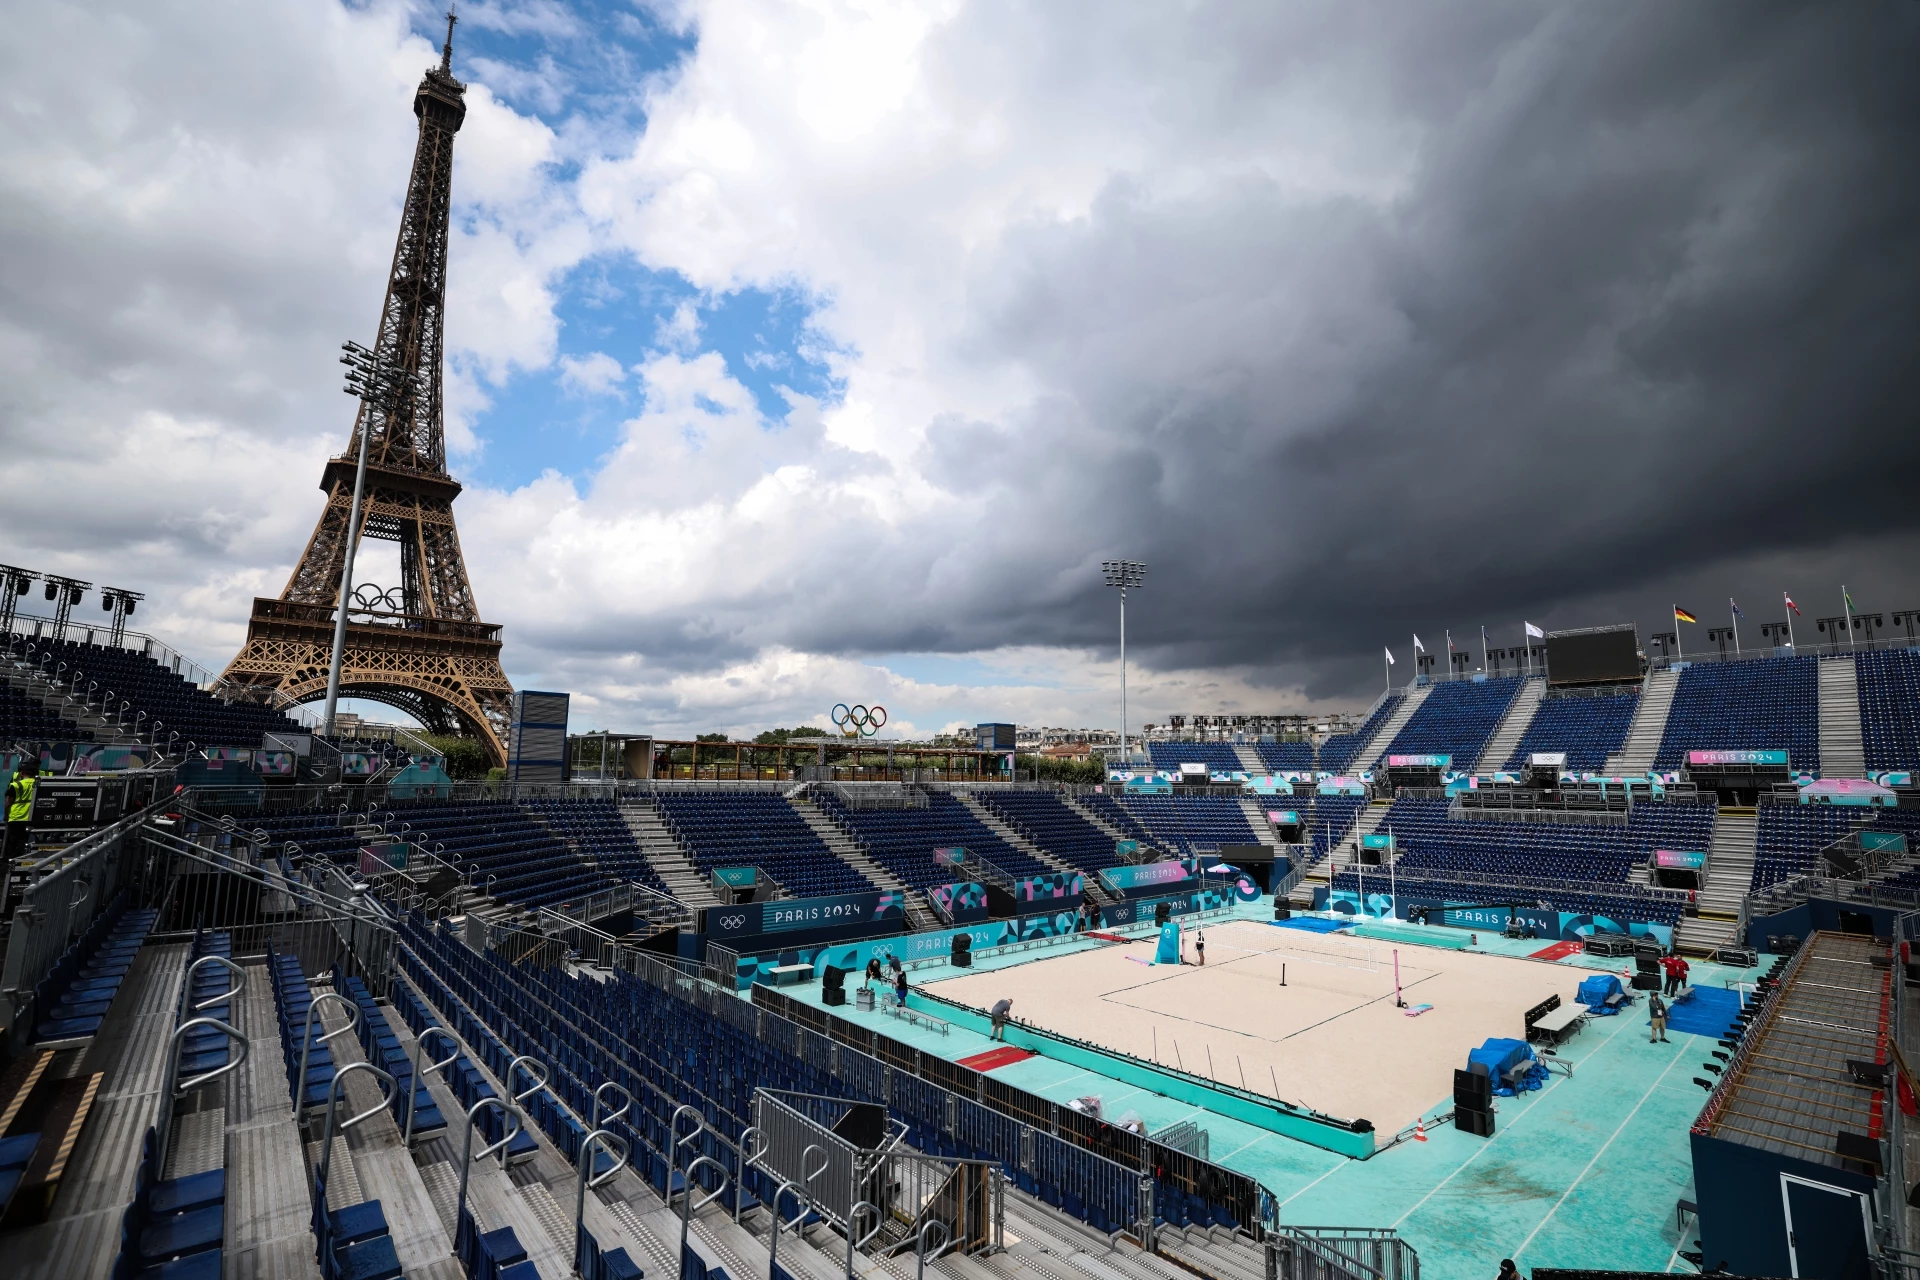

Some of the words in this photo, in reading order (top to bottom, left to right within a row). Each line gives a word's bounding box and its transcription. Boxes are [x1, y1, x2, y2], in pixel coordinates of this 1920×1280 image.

[1740, 753, 1773, 761] 2024
[824, 904, 860, 918] 2024
[1142, 904, 1157, 915] PAR
